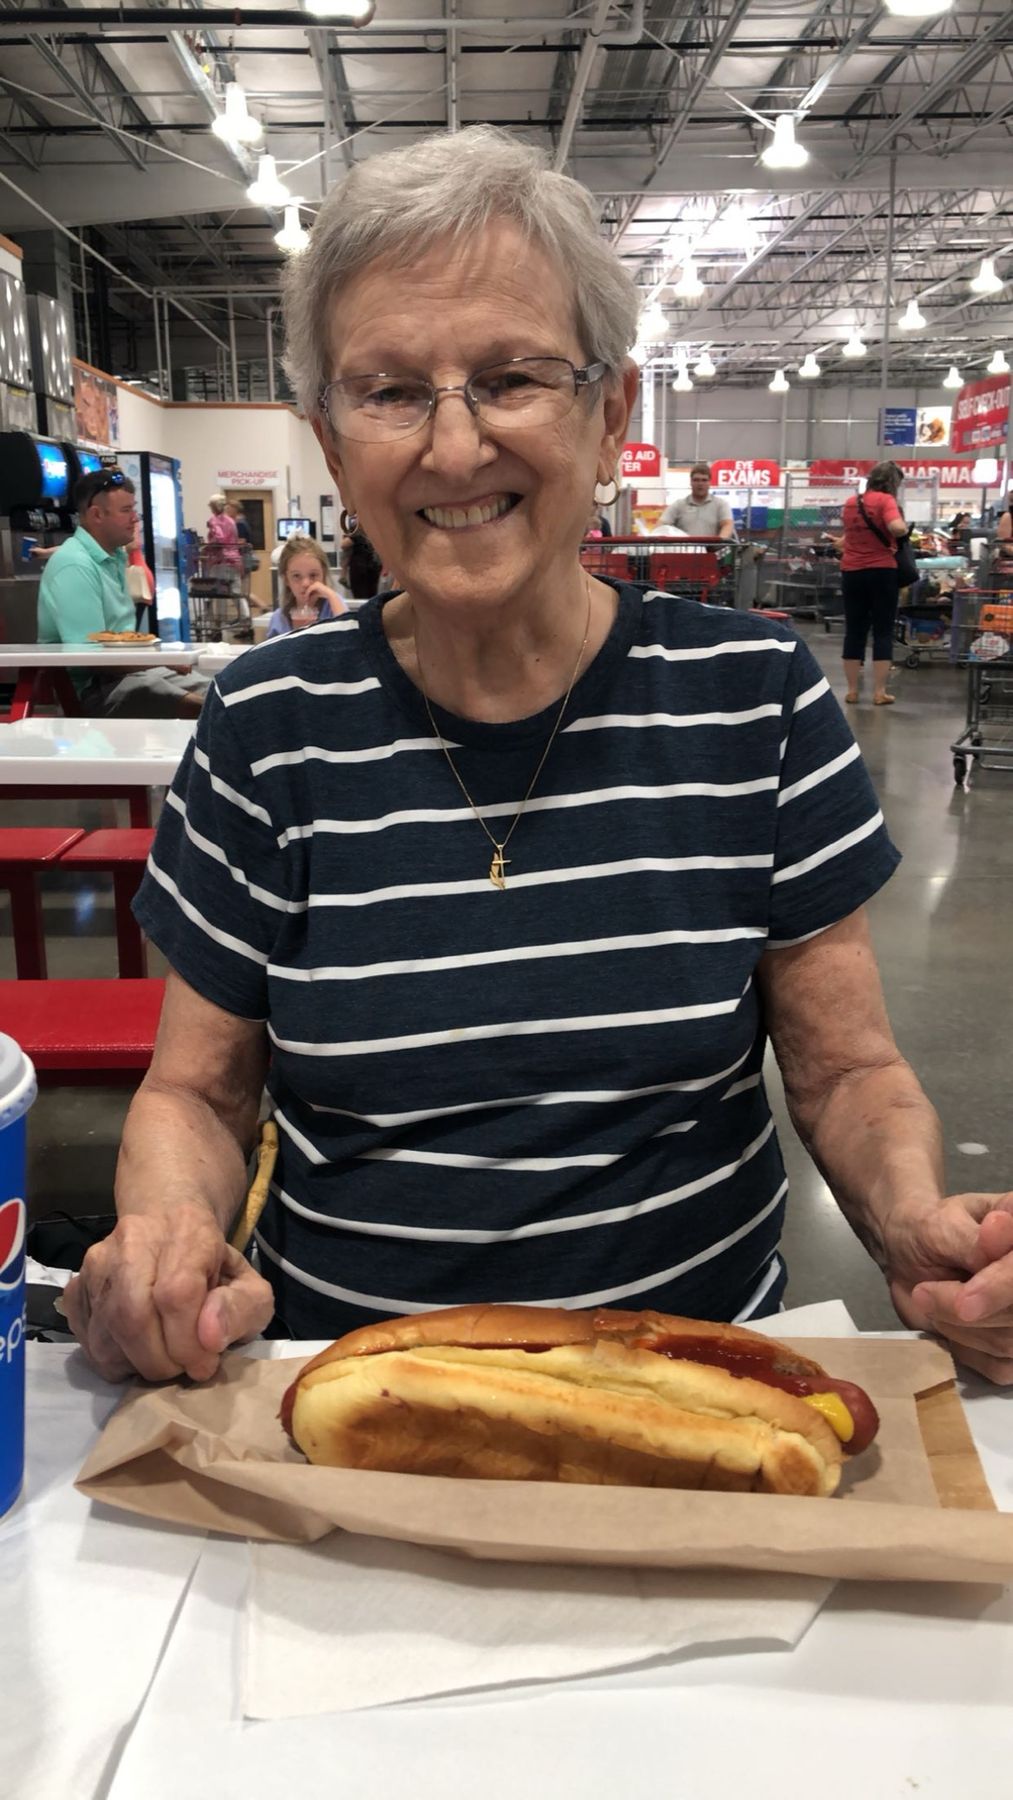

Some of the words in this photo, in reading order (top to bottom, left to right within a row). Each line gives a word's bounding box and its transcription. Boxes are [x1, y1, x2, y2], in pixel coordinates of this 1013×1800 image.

[635, 450, 656, 461] AID
[735, 460, 753, 470] EYE
[217, 470, 278, 478] MERCHANDISE
[718, 469, 771, 485] EXAMS
[231, 478, 265, 486] PICK-UP
